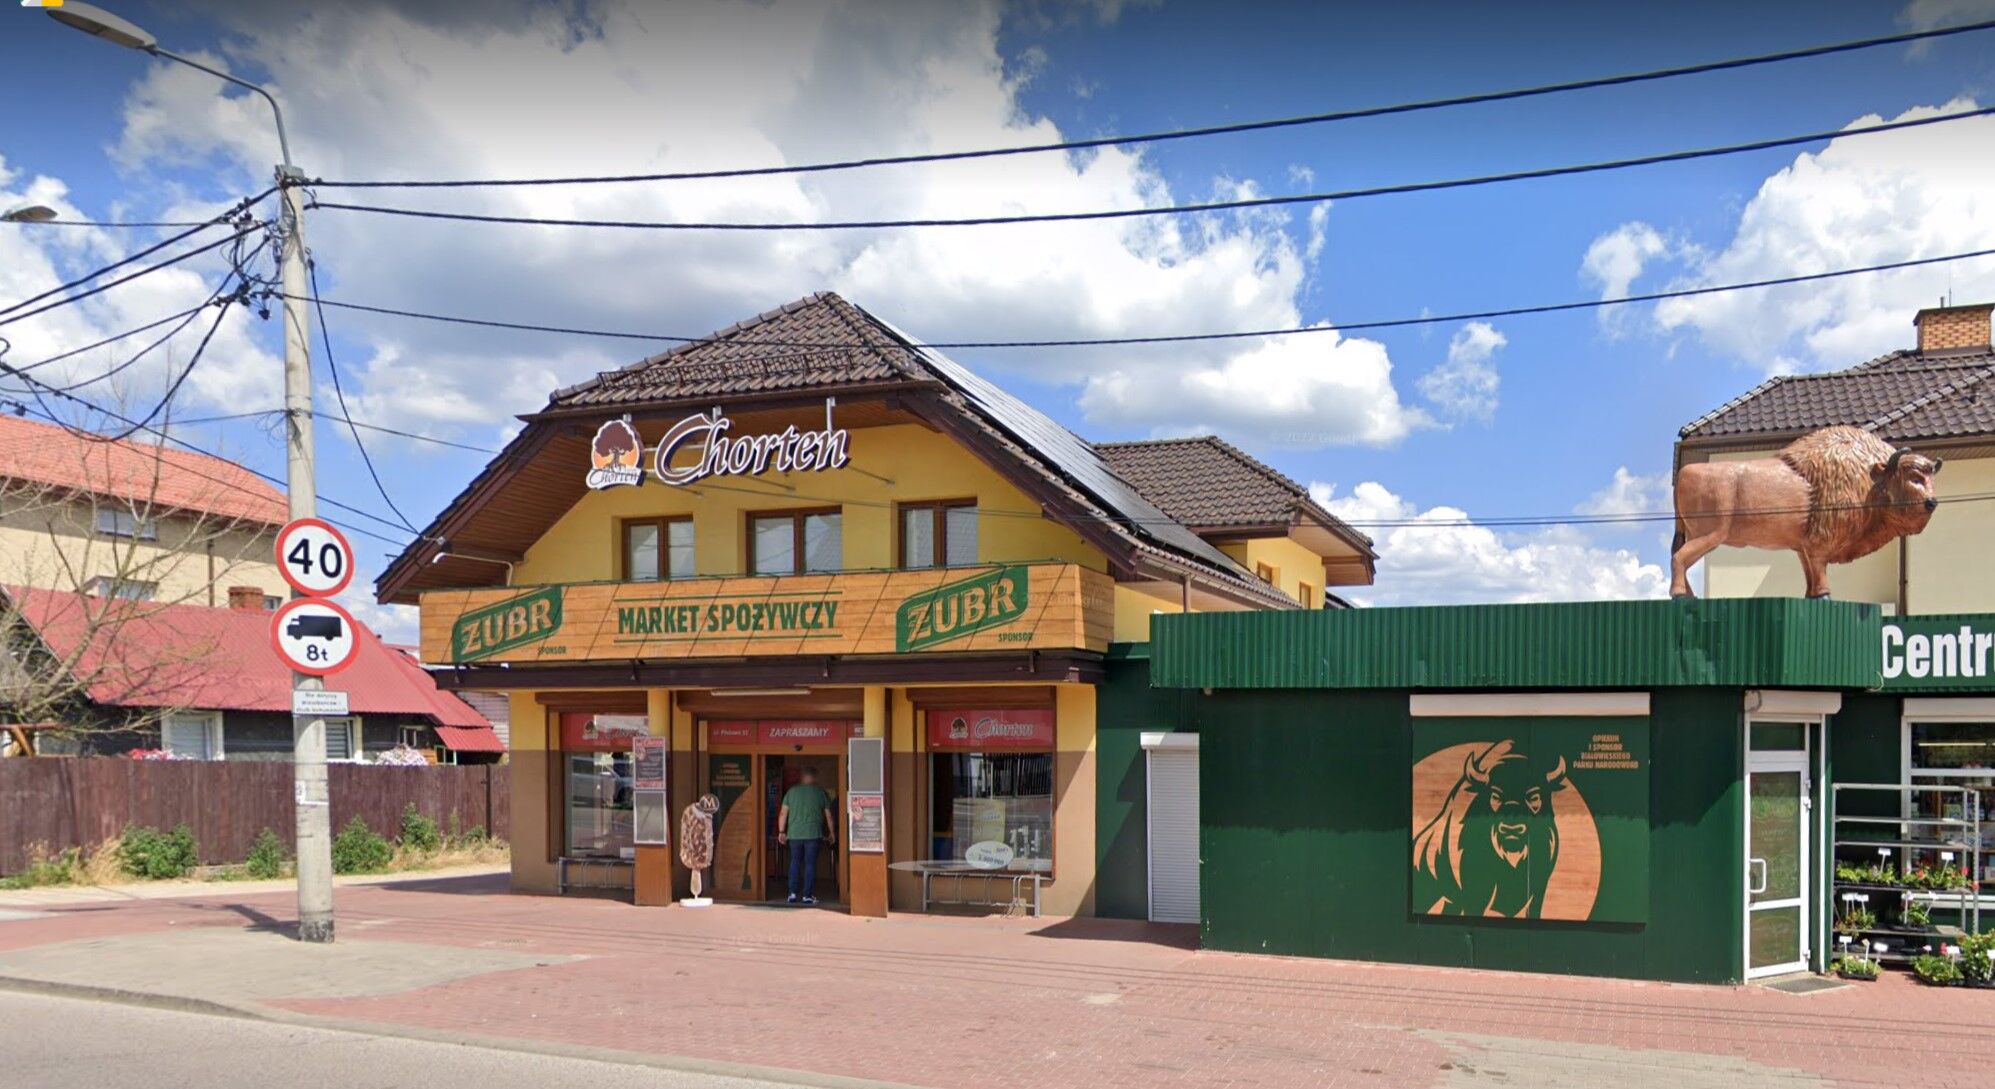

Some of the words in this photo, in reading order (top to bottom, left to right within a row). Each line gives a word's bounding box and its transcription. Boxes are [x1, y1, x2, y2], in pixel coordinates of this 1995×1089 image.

[654, 413, 849, 486] Chorten
[288, 538, 343, 579] 40
[618, 605, 700, 634] MARKET
[998, 631, 1034, 642] SPONSOR
[1881, 624, 1995, 679] Centr
[769, 727, 829, 737] ZAPRASZAMY
